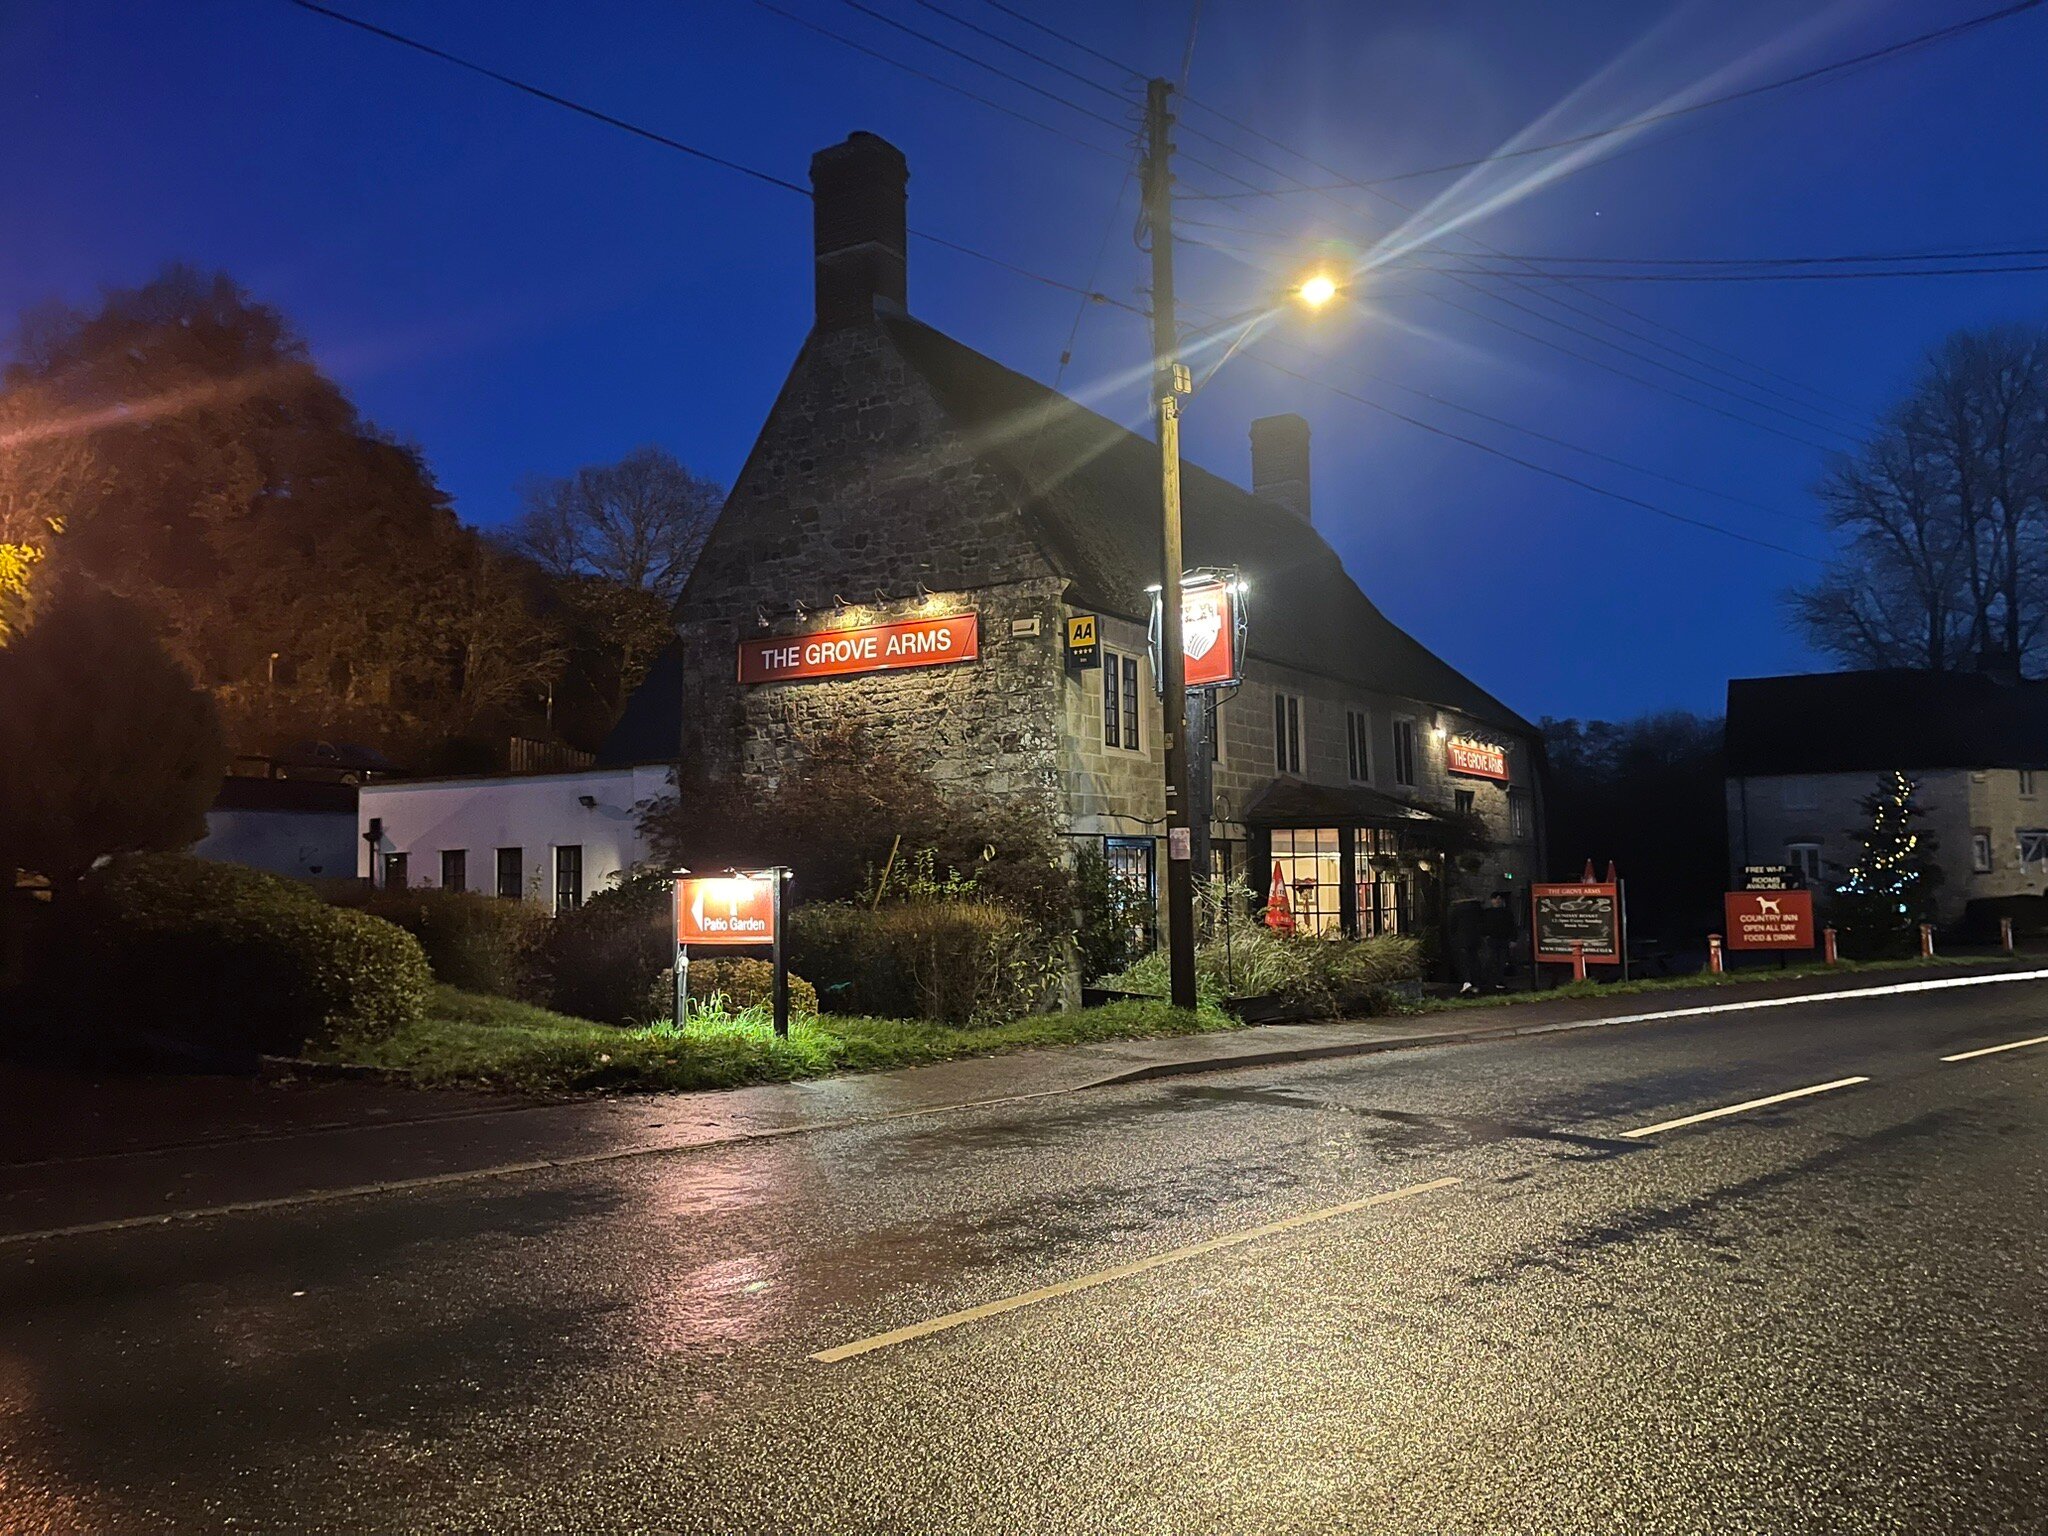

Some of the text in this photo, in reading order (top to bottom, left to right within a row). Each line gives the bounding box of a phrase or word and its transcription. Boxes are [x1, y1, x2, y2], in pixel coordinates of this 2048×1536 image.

[1073, 622, 1092, 640] AA
[762, 628, 951, 669] THE GROVE ARMS
[1454, 749, 1504, 774] THE GROVE ARMS
[704, 917, 765, 931] Patio Garden
[1740, 914, 1780, 922] COUNTRY
[1743, 924, 1765, 932] OPEN
[1743, 934, 1764, 942] FOOD
